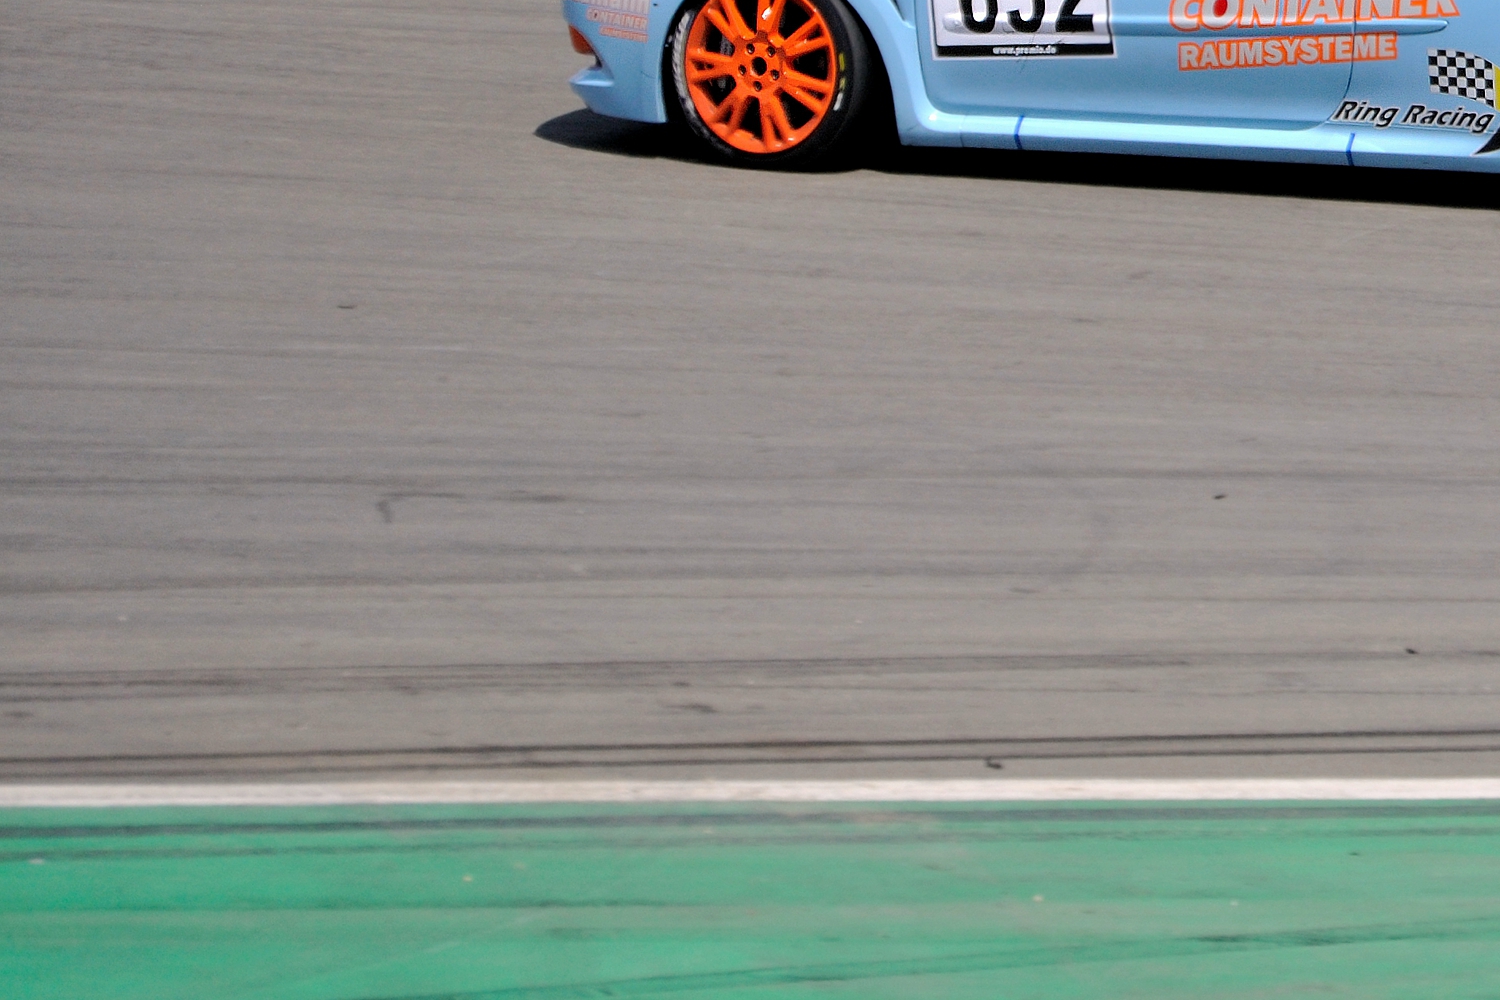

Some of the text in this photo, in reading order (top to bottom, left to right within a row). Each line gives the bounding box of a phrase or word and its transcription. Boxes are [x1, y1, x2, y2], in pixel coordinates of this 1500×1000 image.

[1178, 32, 1397, 71] RAUMSYSTEME
[1333, 100, 1495, 134] Ring Racing
